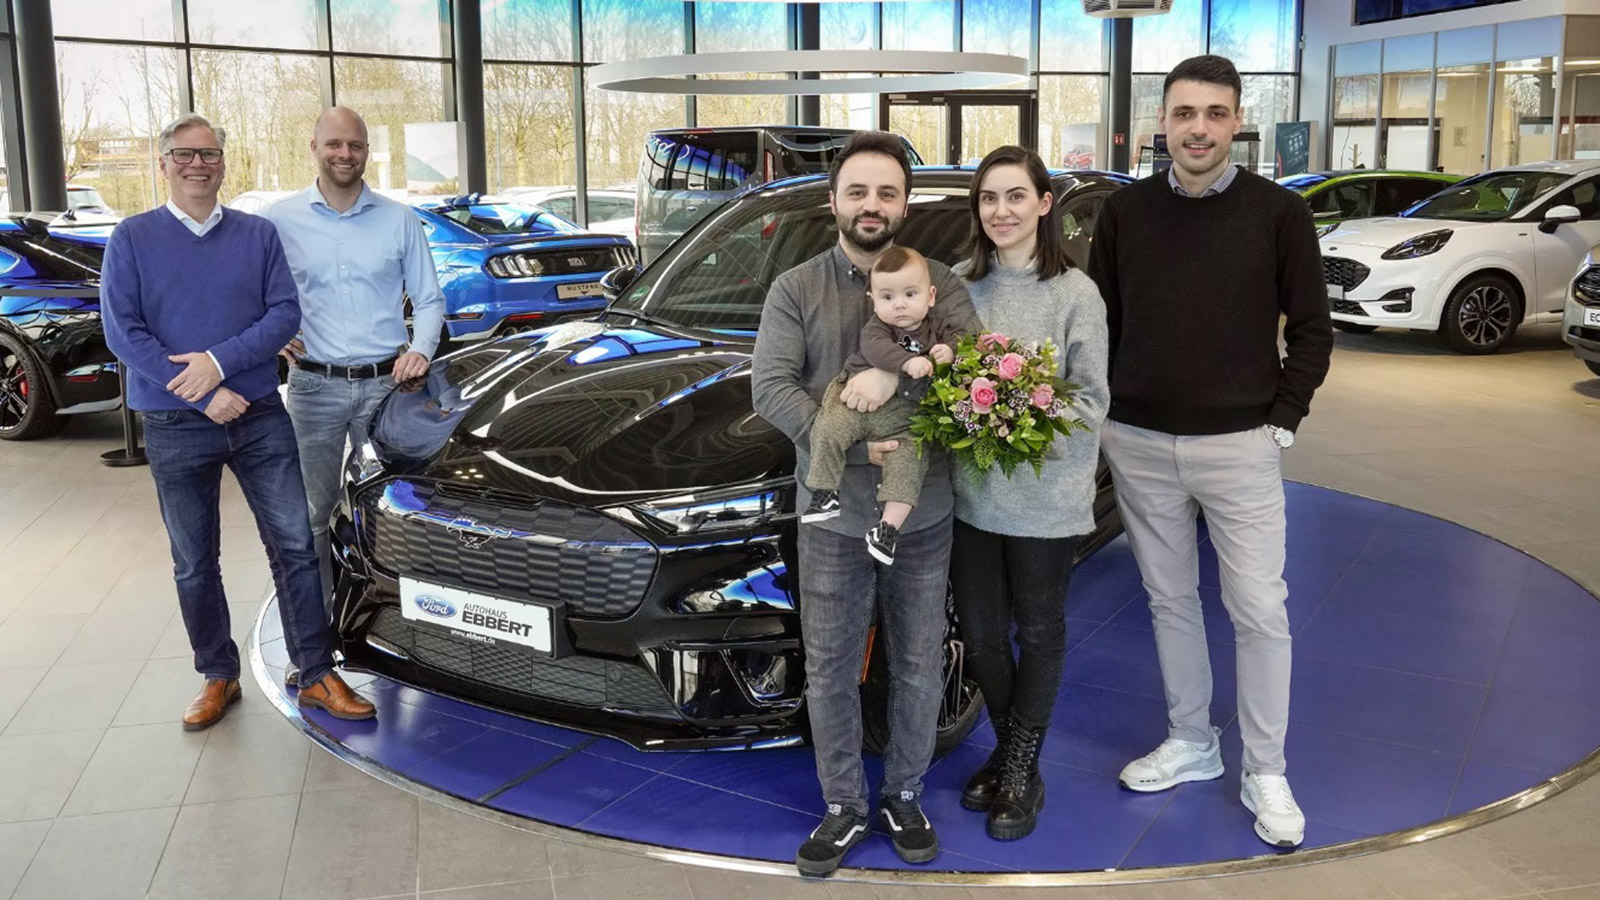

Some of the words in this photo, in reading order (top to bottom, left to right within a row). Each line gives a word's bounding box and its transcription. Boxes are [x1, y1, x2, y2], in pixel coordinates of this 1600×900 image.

[420, 596, 449, 615] Ford
[463, 603, 508, 619] AUTOHAUS
[462, 610, 533, 638] EBBERT
[450, 629, 496, 645] www.ebbert.de
